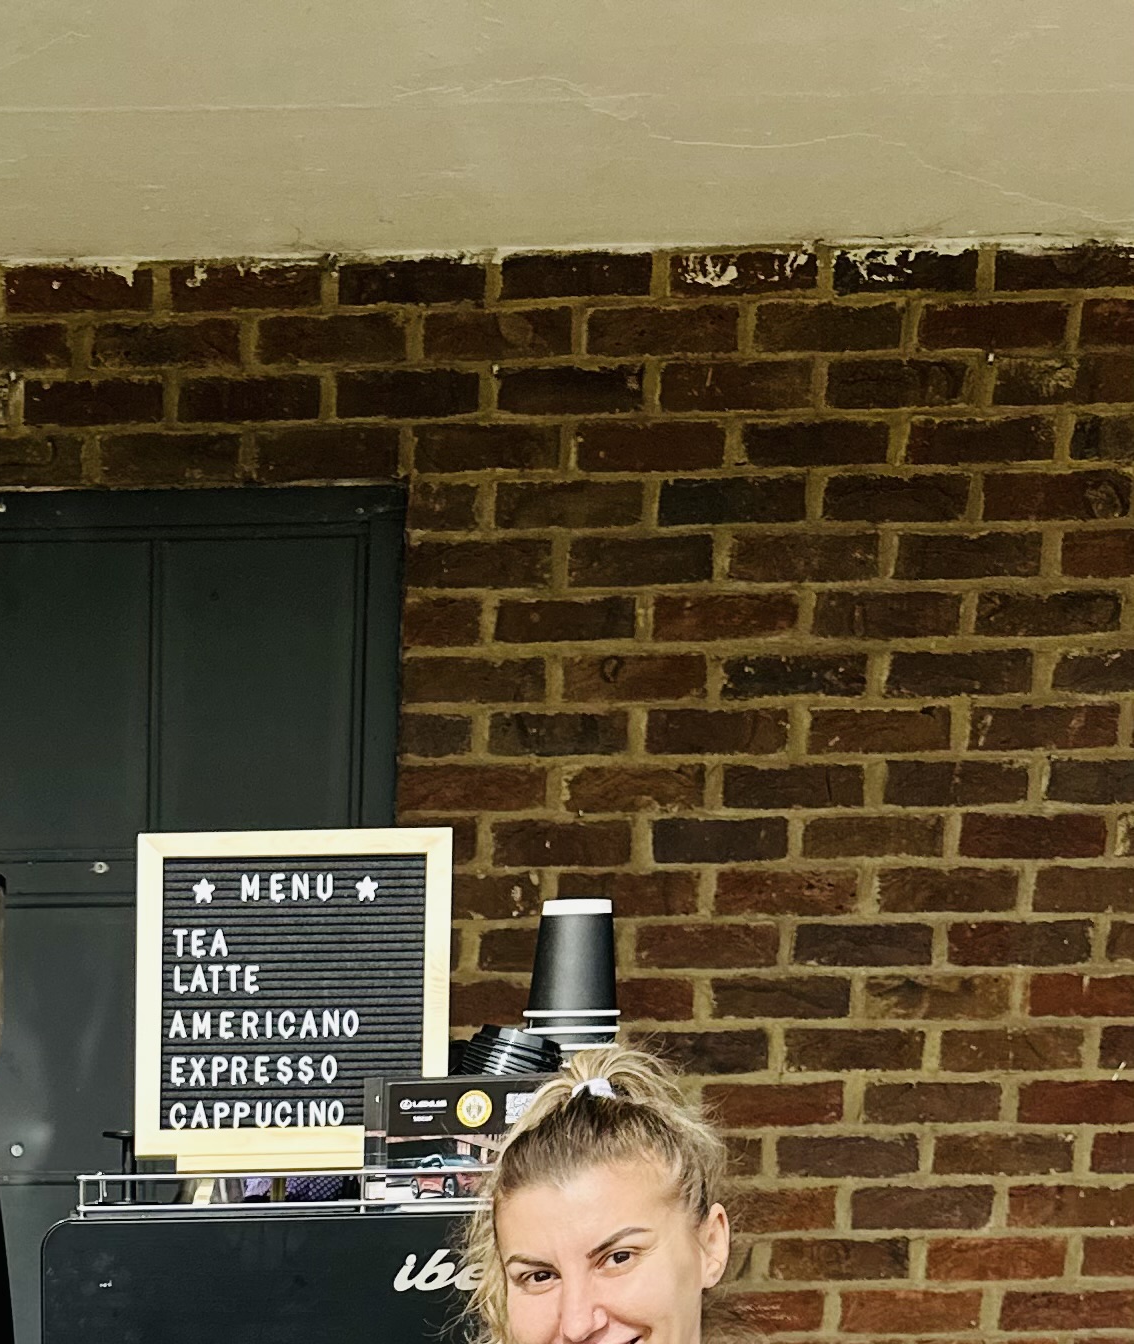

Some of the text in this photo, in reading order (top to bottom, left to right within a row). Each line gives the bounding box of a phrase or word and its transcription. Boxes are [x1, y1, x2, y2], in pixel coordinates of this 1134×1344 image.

[240, 872, 334, 903] MENU
[172, 928, 229, 959] TEA
[173, 964, 260, 995] LATTE
[169, 1009, 360, 1040] AMERICANO
[170, 1055, 338, 1087] EXPRESSO
[170, 1100, 345, 1130] CAPPUCINO
